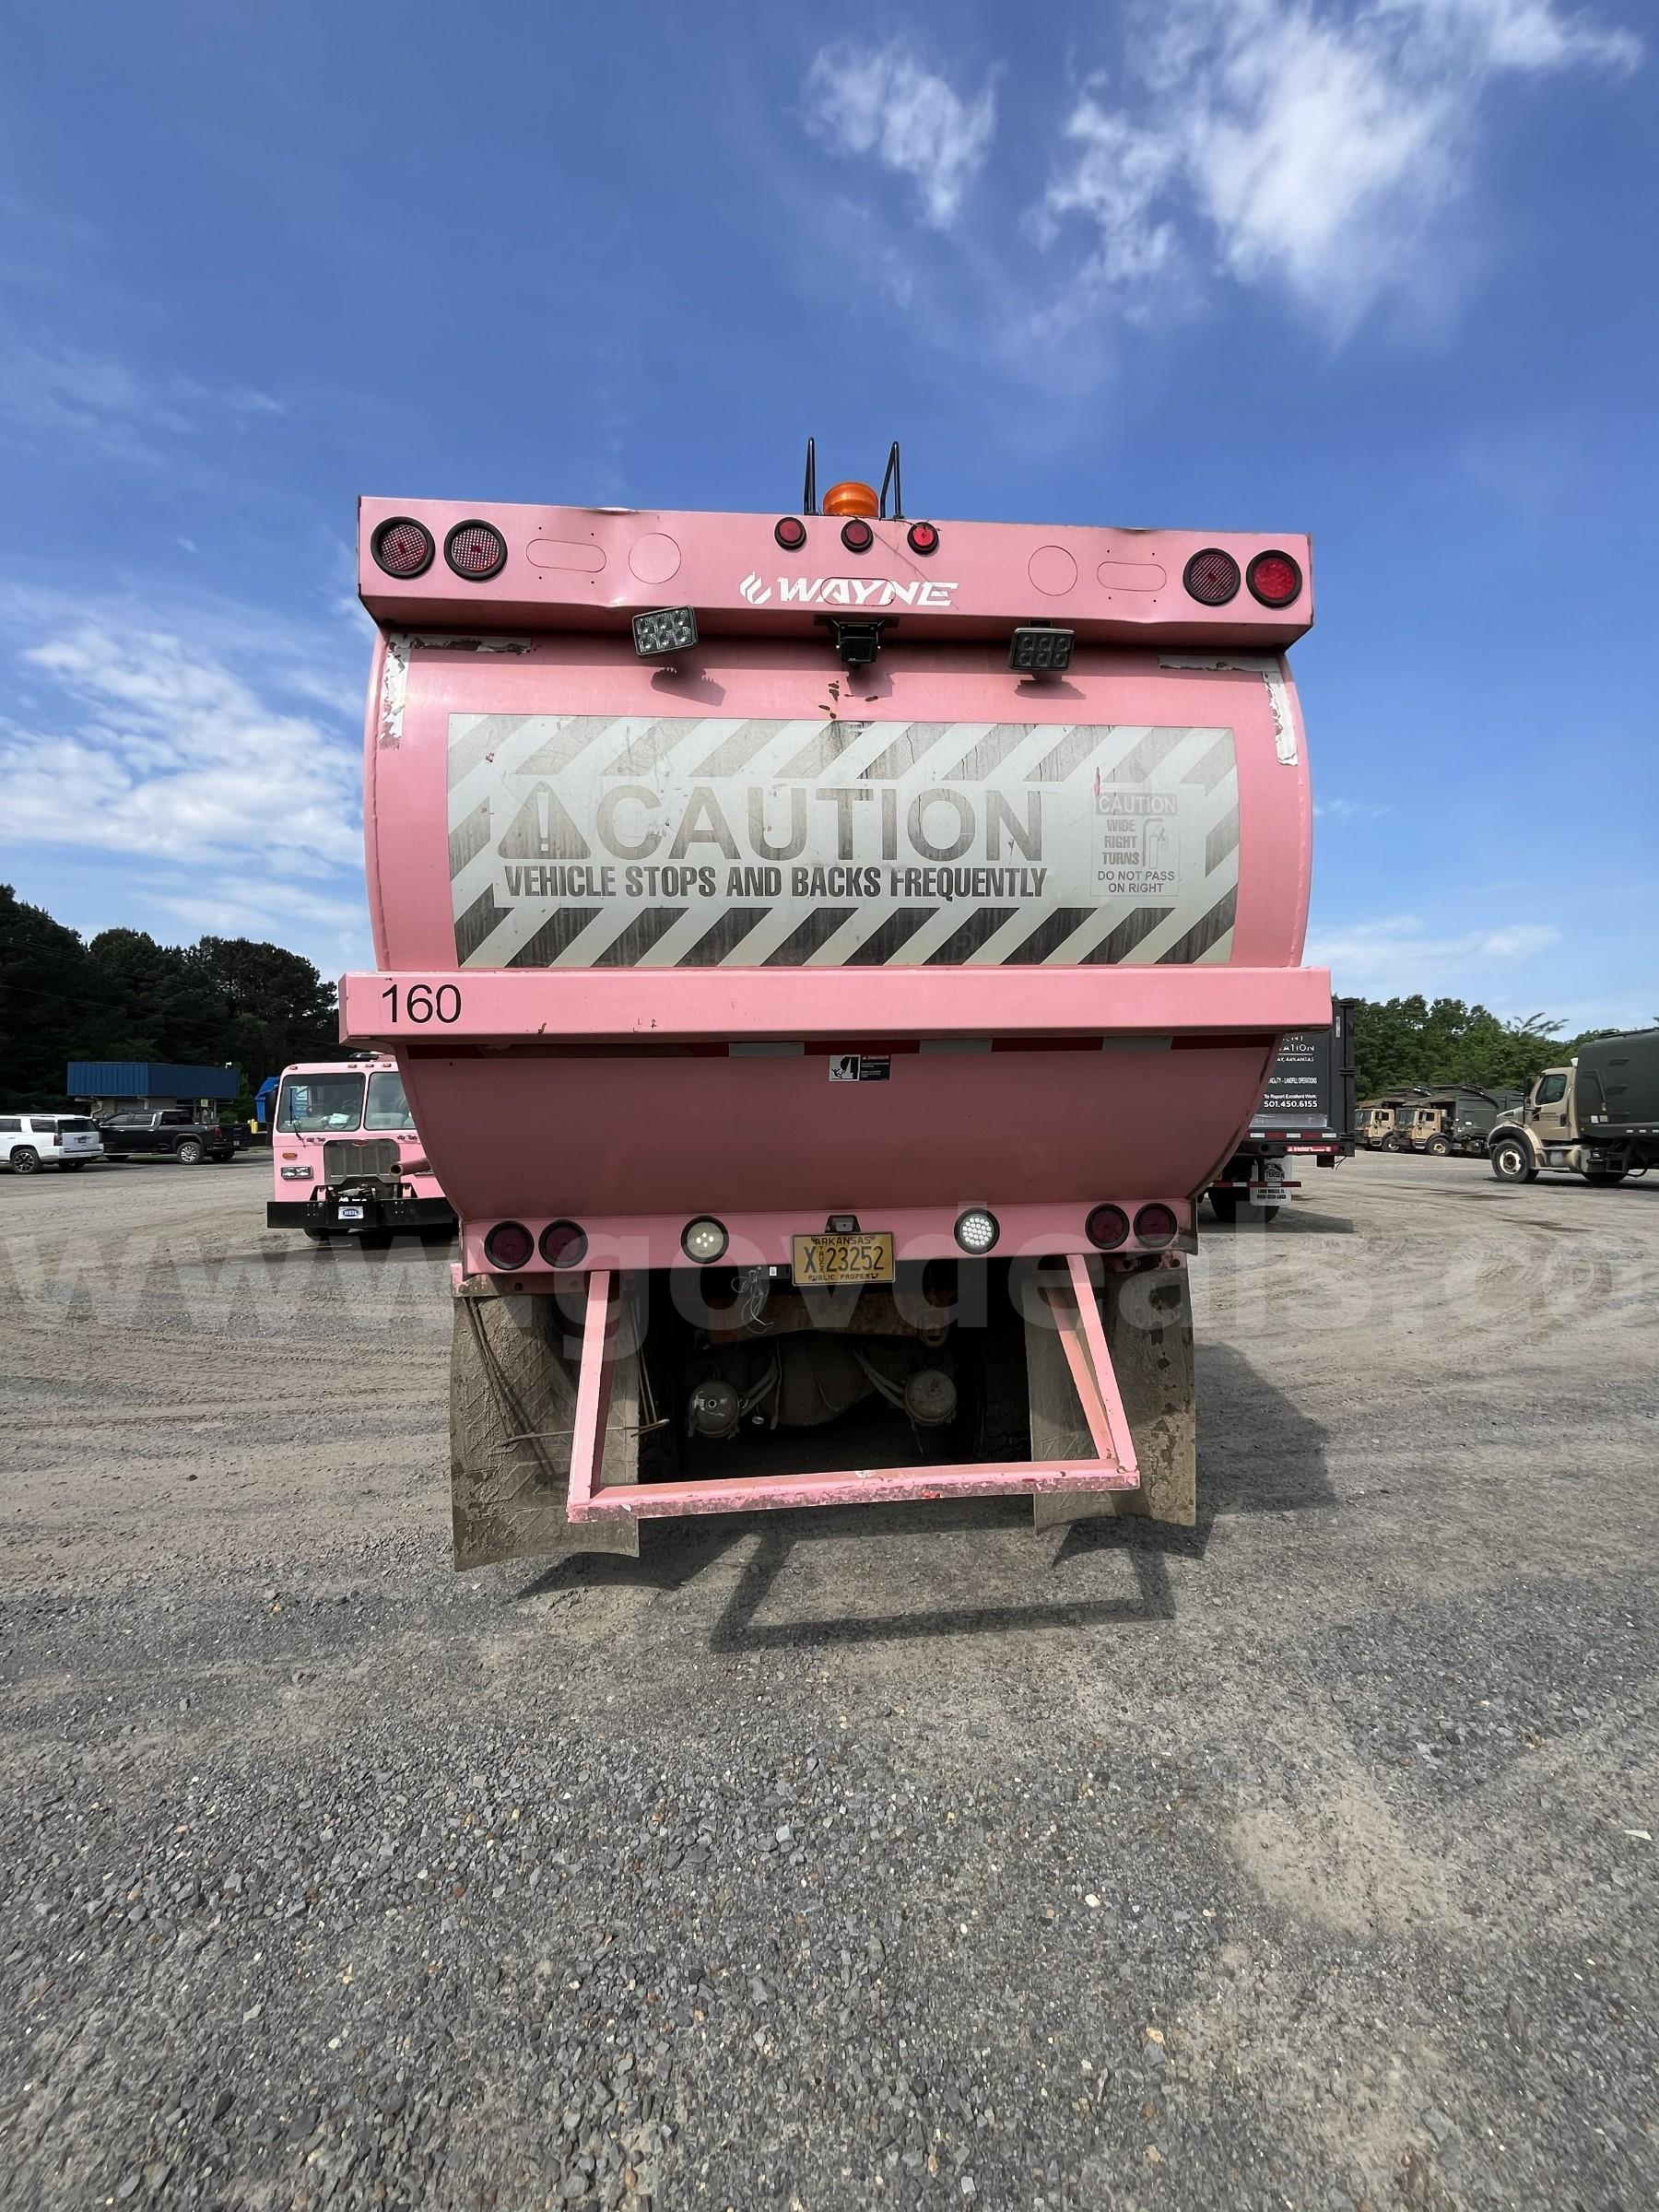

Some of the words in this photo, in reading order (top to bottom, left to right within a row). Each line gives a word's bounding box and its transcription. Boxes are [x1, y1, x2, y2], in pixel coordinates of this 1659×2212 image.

[777, 577, 959, 606] WAYNE
[1099, 796, 1176, 813] CAUTION
[596, 784, 1042, 862] CAUTION
[1106, 819, 1135, 831] WIDE
[1104, 835, 1137, 848] RIGHT
[1101, 852, 1139, 865] TURNS
[1098, 870, 1114, 881] DO
[1118, 870, 1143, 881] NOT
[1146, 870, 1175, 881] PASS
[504, 865, 617, 898] VEHICLE
[625, 865, 716, 898] STOPS
[726, 866, 782, 898] AND
[792, 866, 881, 898] BACKS
[890, 867, 1047, 901] FREQUENTLY
[1108, 883, 1125, 893] ON
[1128, 883, 1164, 893] RIGHT
[382, 983, 462, 1024] 160
[1264, 1100, 1318, 1108] 501.450.6155
[814, 1236, 872, 1246] ARKANSAS
[804, 1245, 817, 1273] X
[826, 1245, 885, 1273] 23252
[807, 1274, 835, 1282] PUBLIC
[840, 1272, 880, 1280] PROPERTY
